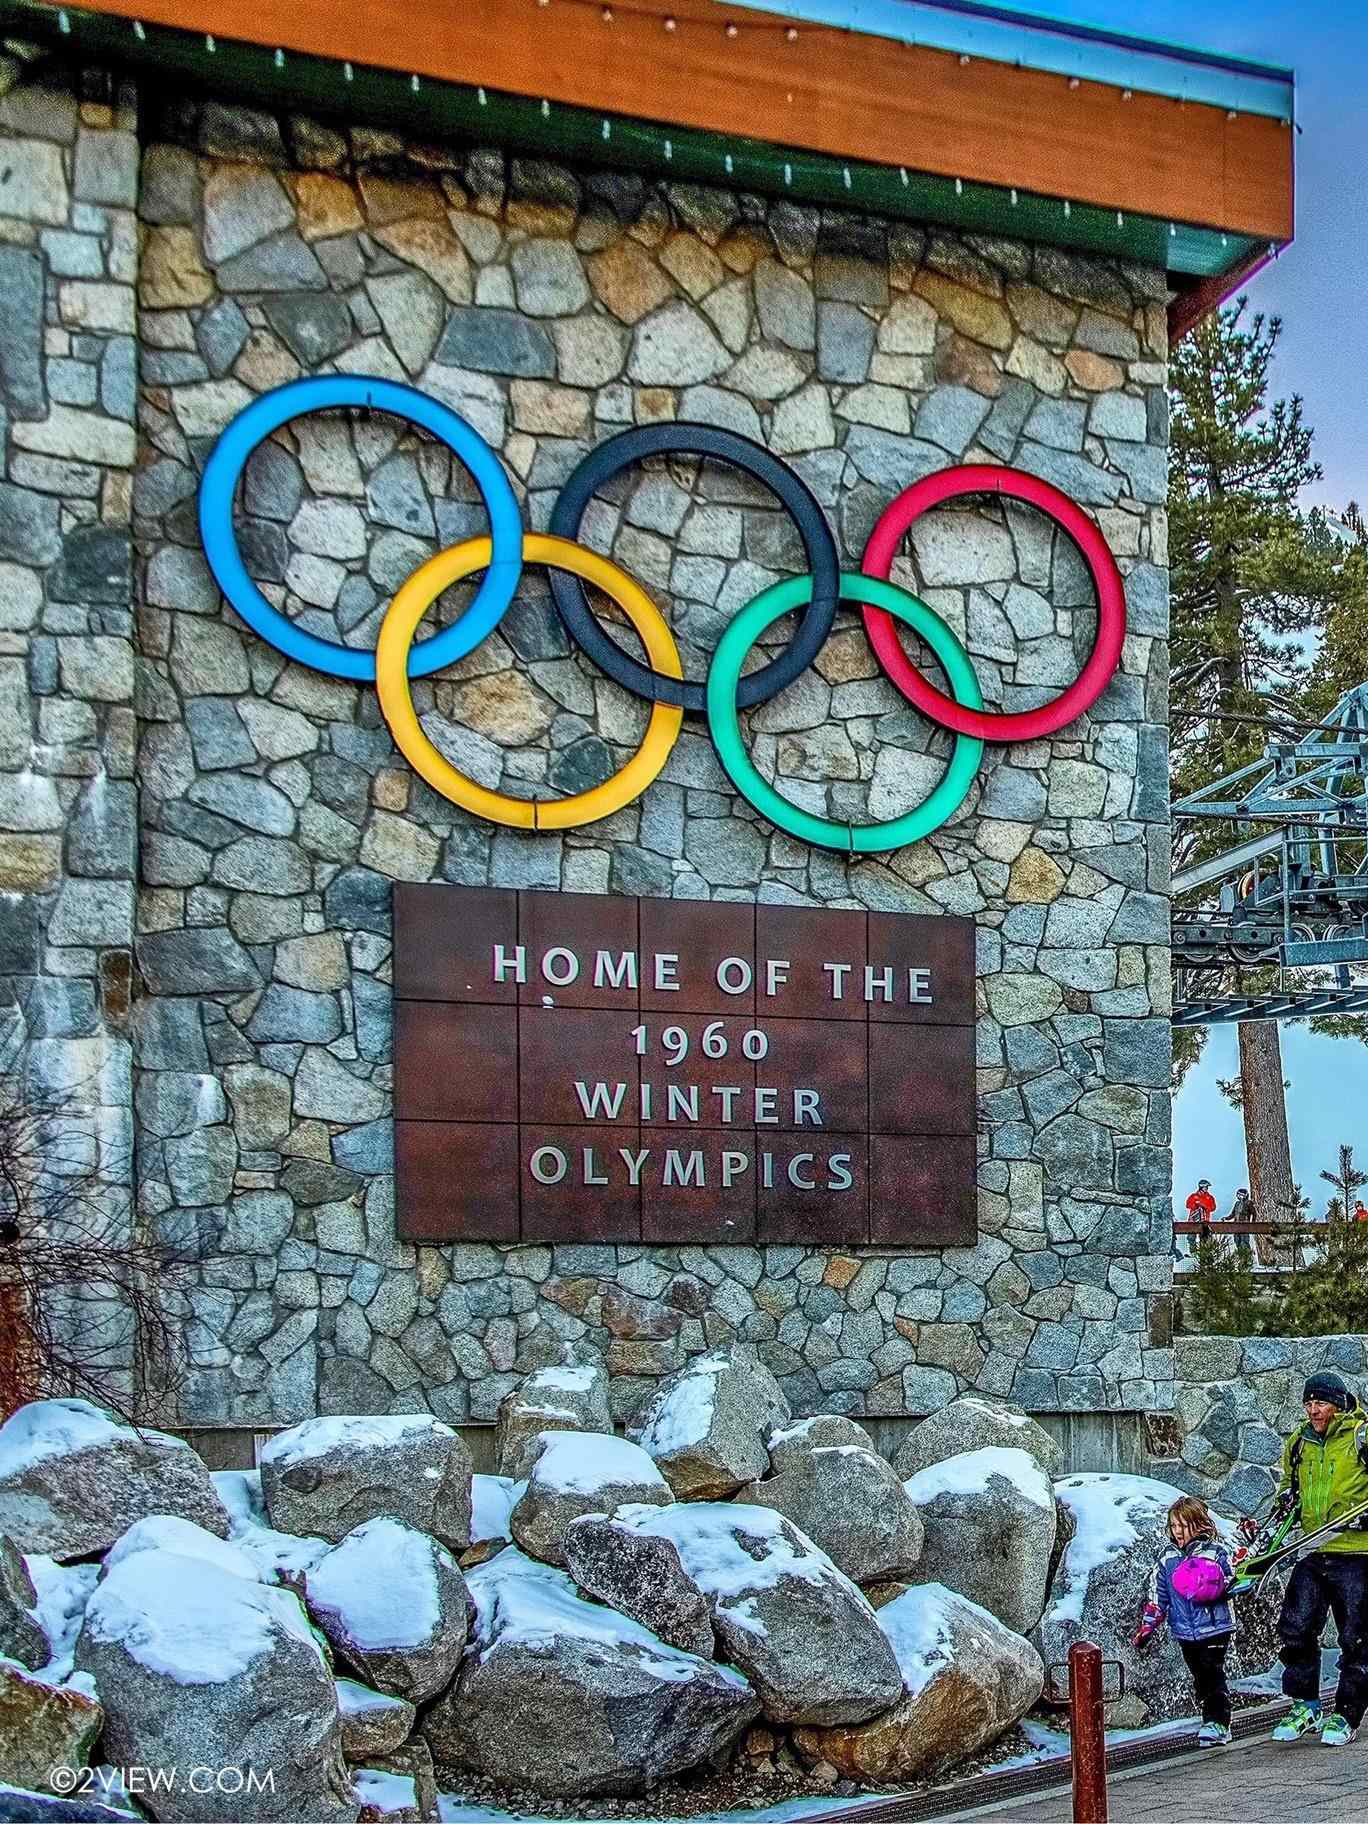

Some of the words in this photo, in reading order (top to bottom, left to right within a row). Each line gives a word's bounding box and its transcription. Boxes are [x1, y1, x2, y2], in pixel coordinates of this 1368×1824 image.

[491, 943, 681, 991] HOME
[716, 957, 791, 996] OF
[823, 963, 934, 1004] THE
[630, 1022, 770, 1066] 1960
[574, 1082, 823, 1125] WINTER
[530, 1146, 854, 1190] OLYMPICS
